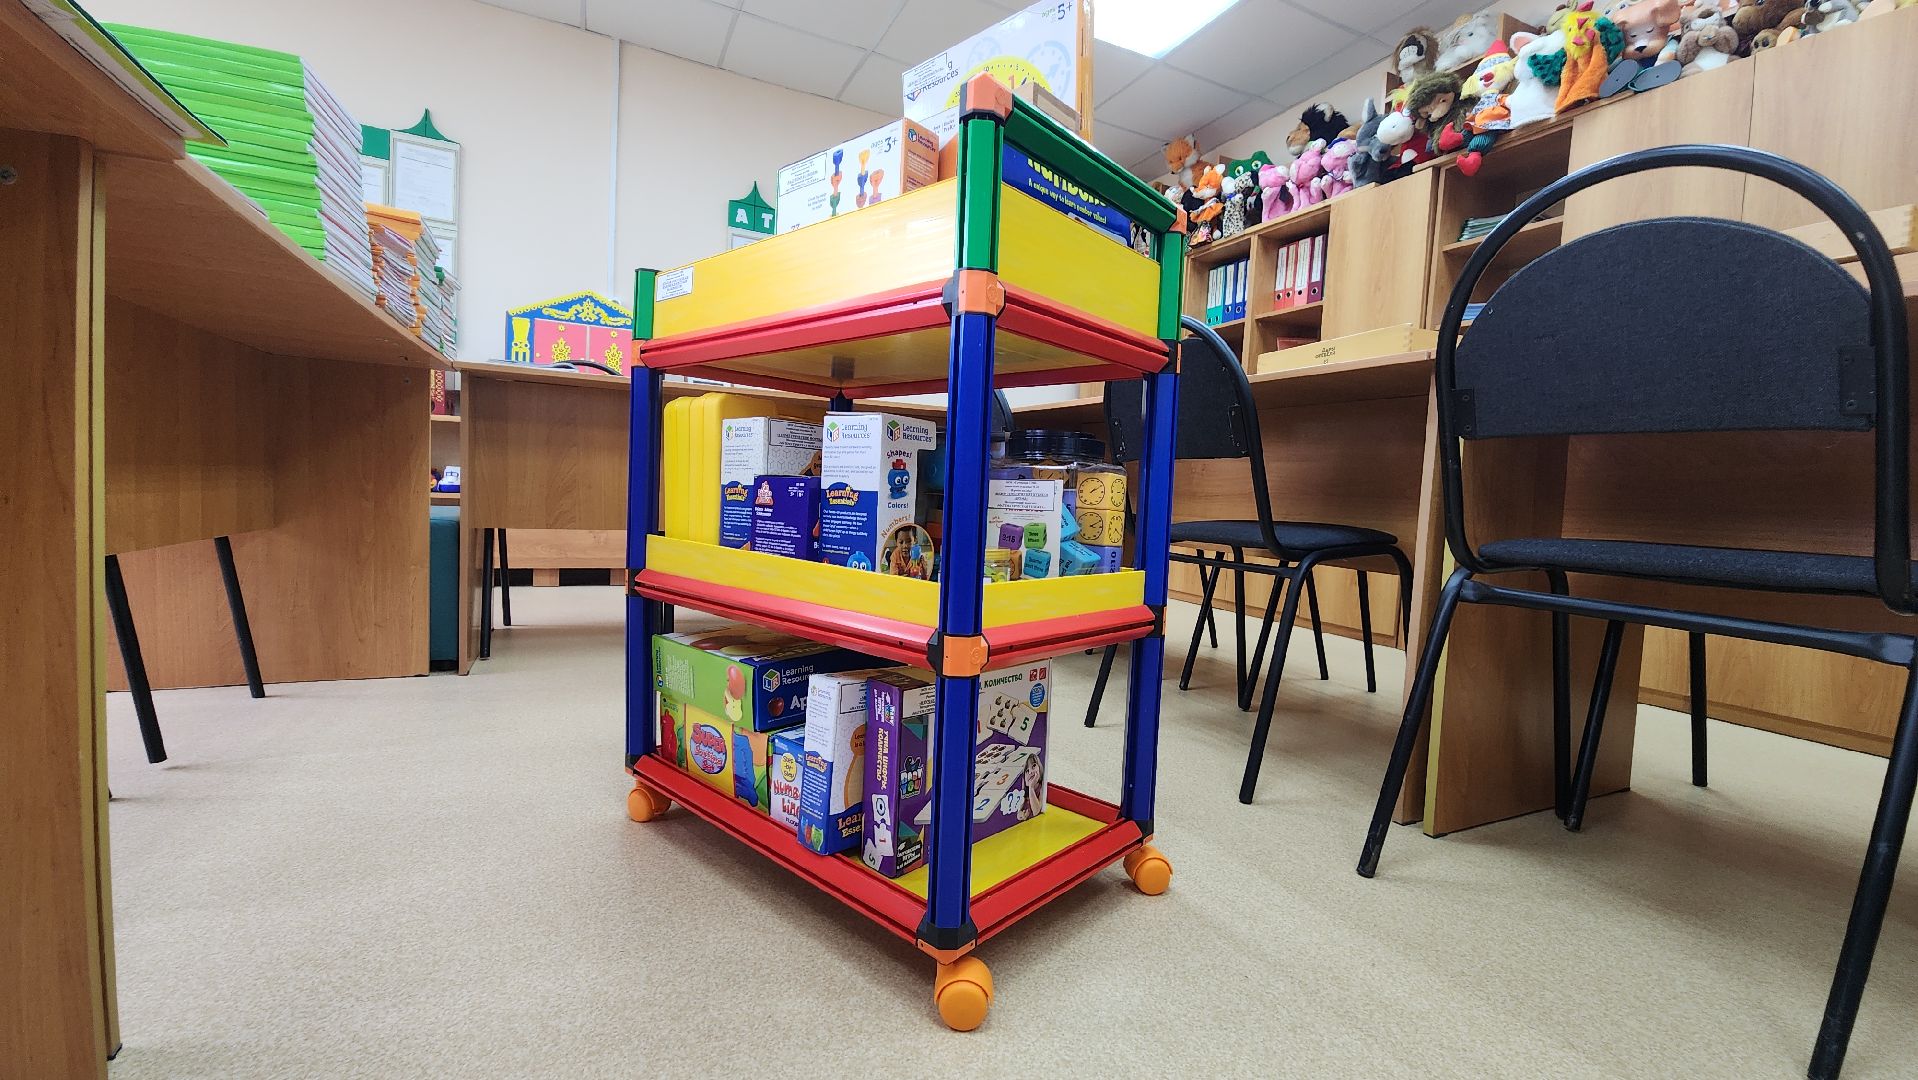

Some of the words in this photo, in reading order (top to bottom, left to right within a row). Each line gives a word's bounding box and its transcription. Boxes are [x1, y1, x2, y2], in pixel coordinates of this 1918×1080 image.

[1057, 2, 1073, 20] 5+
[883, 136, 899, 153] 3+
[842, 422, 868, 431] Learning
[902, 423, 929, 435] Learning
[902, 432, 933, 443] Resources
[886, 449, 913, 459] Shapes!
[724, 486, 748, 497] Learning
[825, 488, 860, 501] Learning
[887, 501, 909, 509] Colors!
[880, 513, 912, 538] Numbers!
[781, 664, 815, 678] Learning
[781, 673, 814, 687] Resour
[984, 673, 1023, 689] КОЛИЧЕСТВО
[1020, 716, 1029, 731] 5
[1012, 752, 1028, 763] 7
[996, 773, 1009, 785] 3
[974, 798, 991, 811] 2
[837, 812, 862, 831] Lear
